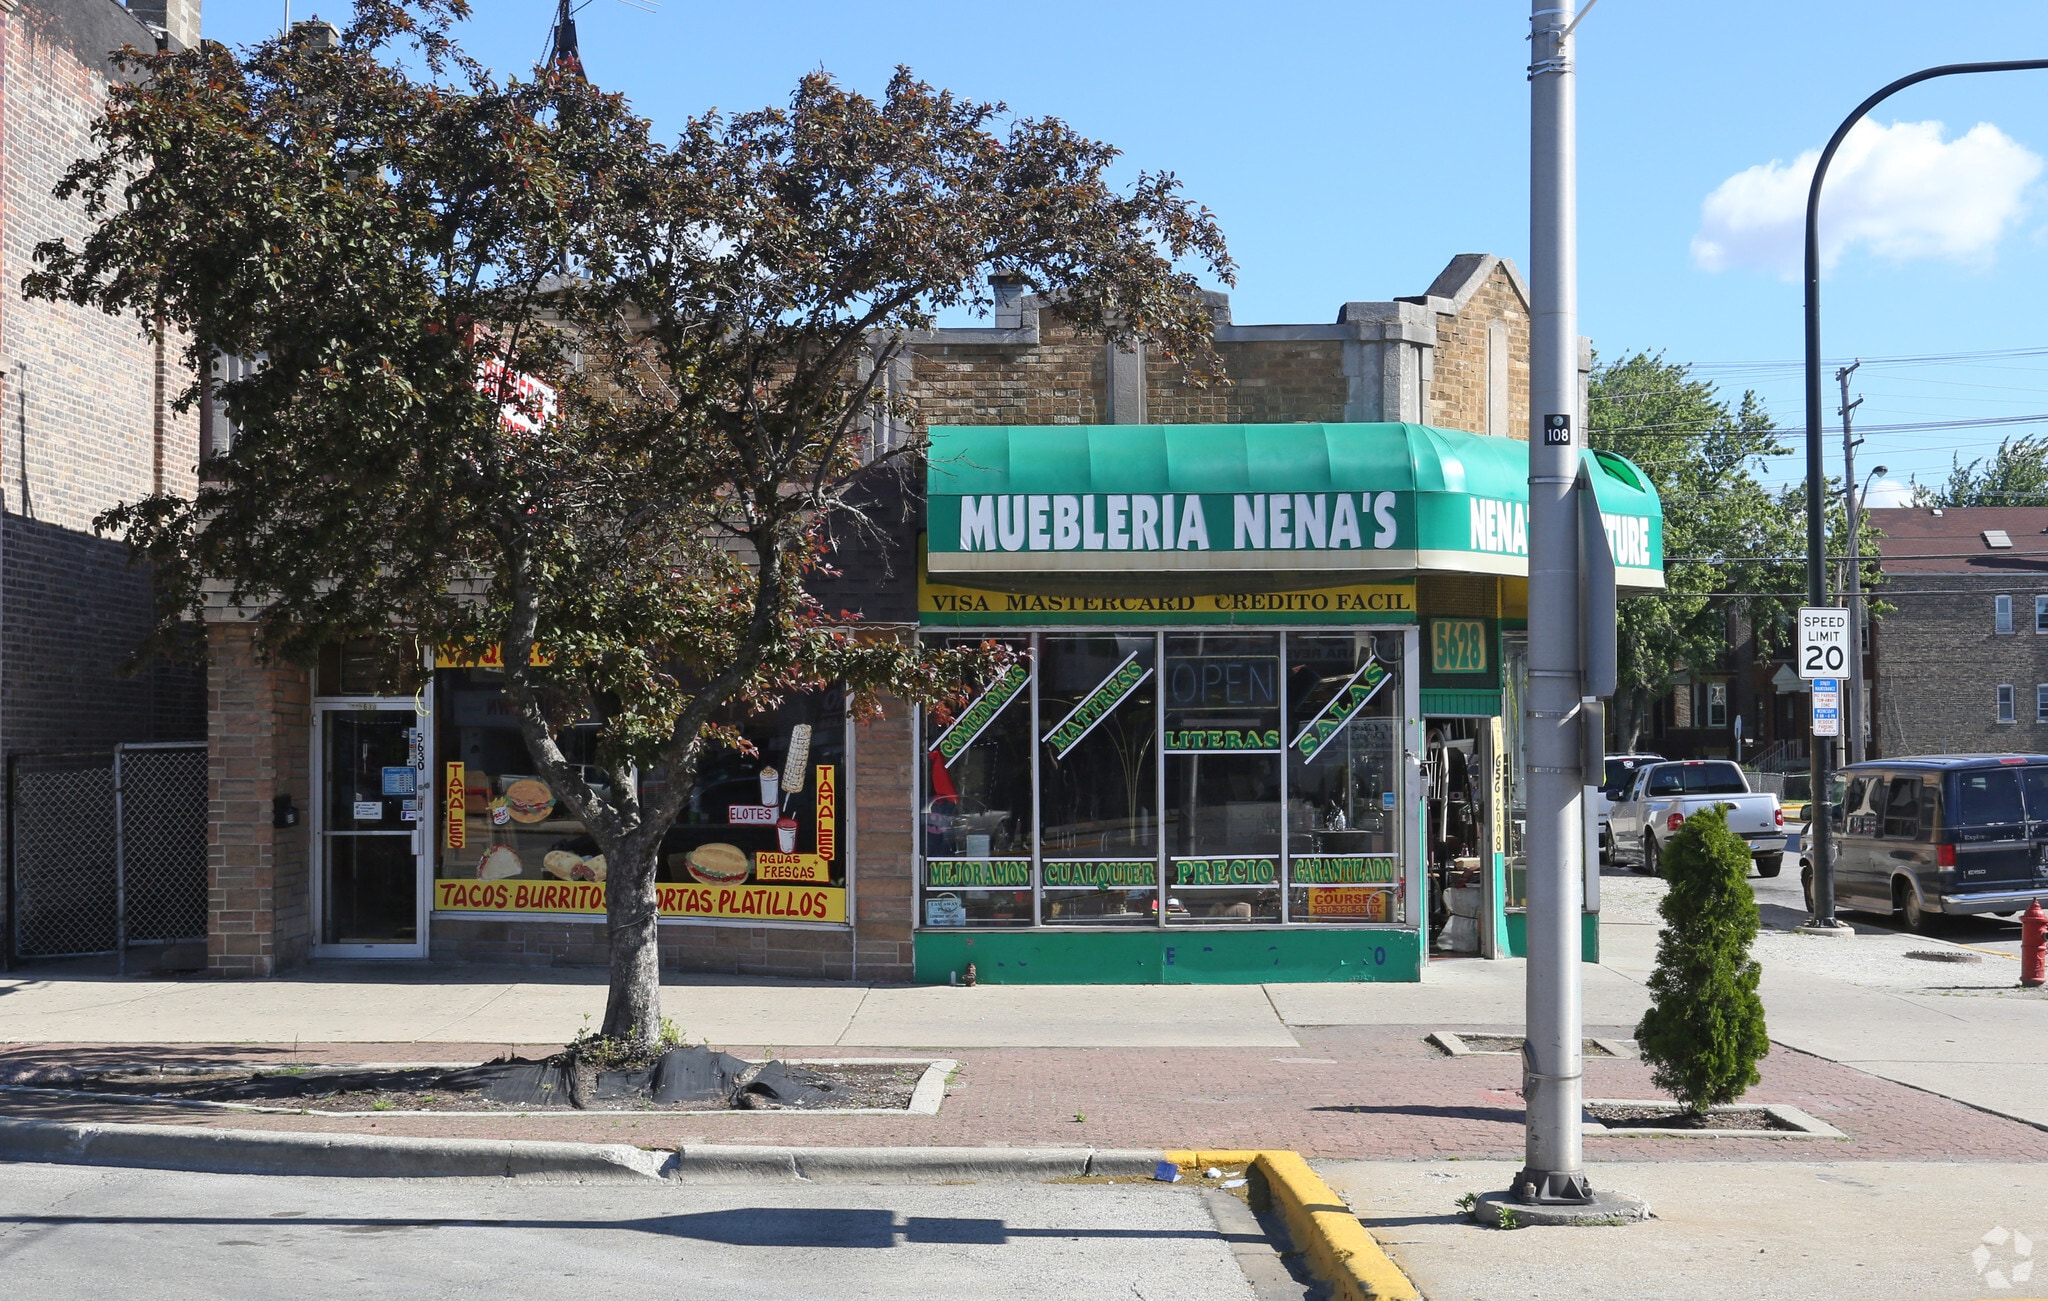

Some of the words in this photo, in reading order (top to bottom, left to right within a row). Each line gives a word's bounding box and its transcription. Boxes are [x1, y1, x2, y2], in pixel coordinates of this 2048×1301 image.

[1547, 428, 1569, 442] 108
[960, 494, 1210, 552] MUEBLERIA
[1234, 491, 1397, 550] NENA'S
[1470, 497, 1530, 555] NENA'
[932, 595, 990, 612] VISA
[1005, 594, 1196, 612] MASTERCARD
[1215, 593, 1329, 612] CREDITO
[1335, 593, 1411, 611] FACIL
[1804, 616, 1844, 628] SPEED
[1808, 631, 1840, 642] LIMIT
[1436, 621, 1482, 669] 5628
[1805, 645, 1844, 671] 20
[1172, 662, 1273, 704] OPEN
[940, 663, 1027, 758] COMEDORES
[1050, 660, 1143, 752] MATTRESS
[1298, 662, 1385, 756] SALAS
[417, 732, 425, 771] 5630
[1165, 730, 1280, 750] LITERAS
[448, 764, 464, 849] TAMALES
[730, 807, 772, 820] ELOTES
[817, 766, 834, 861] TAMALES
[759, 854, 801, 864] AGUAS
[763, 866, 815, 879] FRESCAS
[929, 861, 1029, 886] MEJORAMOS
[1044, 862, 1156, 891] CUALQUIER
[1176, 858, 1275, 885] PRECIO
[1294, 857, 1393, 884] GARANTIZADO
[440, 883, 508, 909] TACOS
[655, 888, 713, 914] ORTAS
[718, 889, 828, 919] PLATILLOS
[1314, 893, 1380, 905] COURSES
